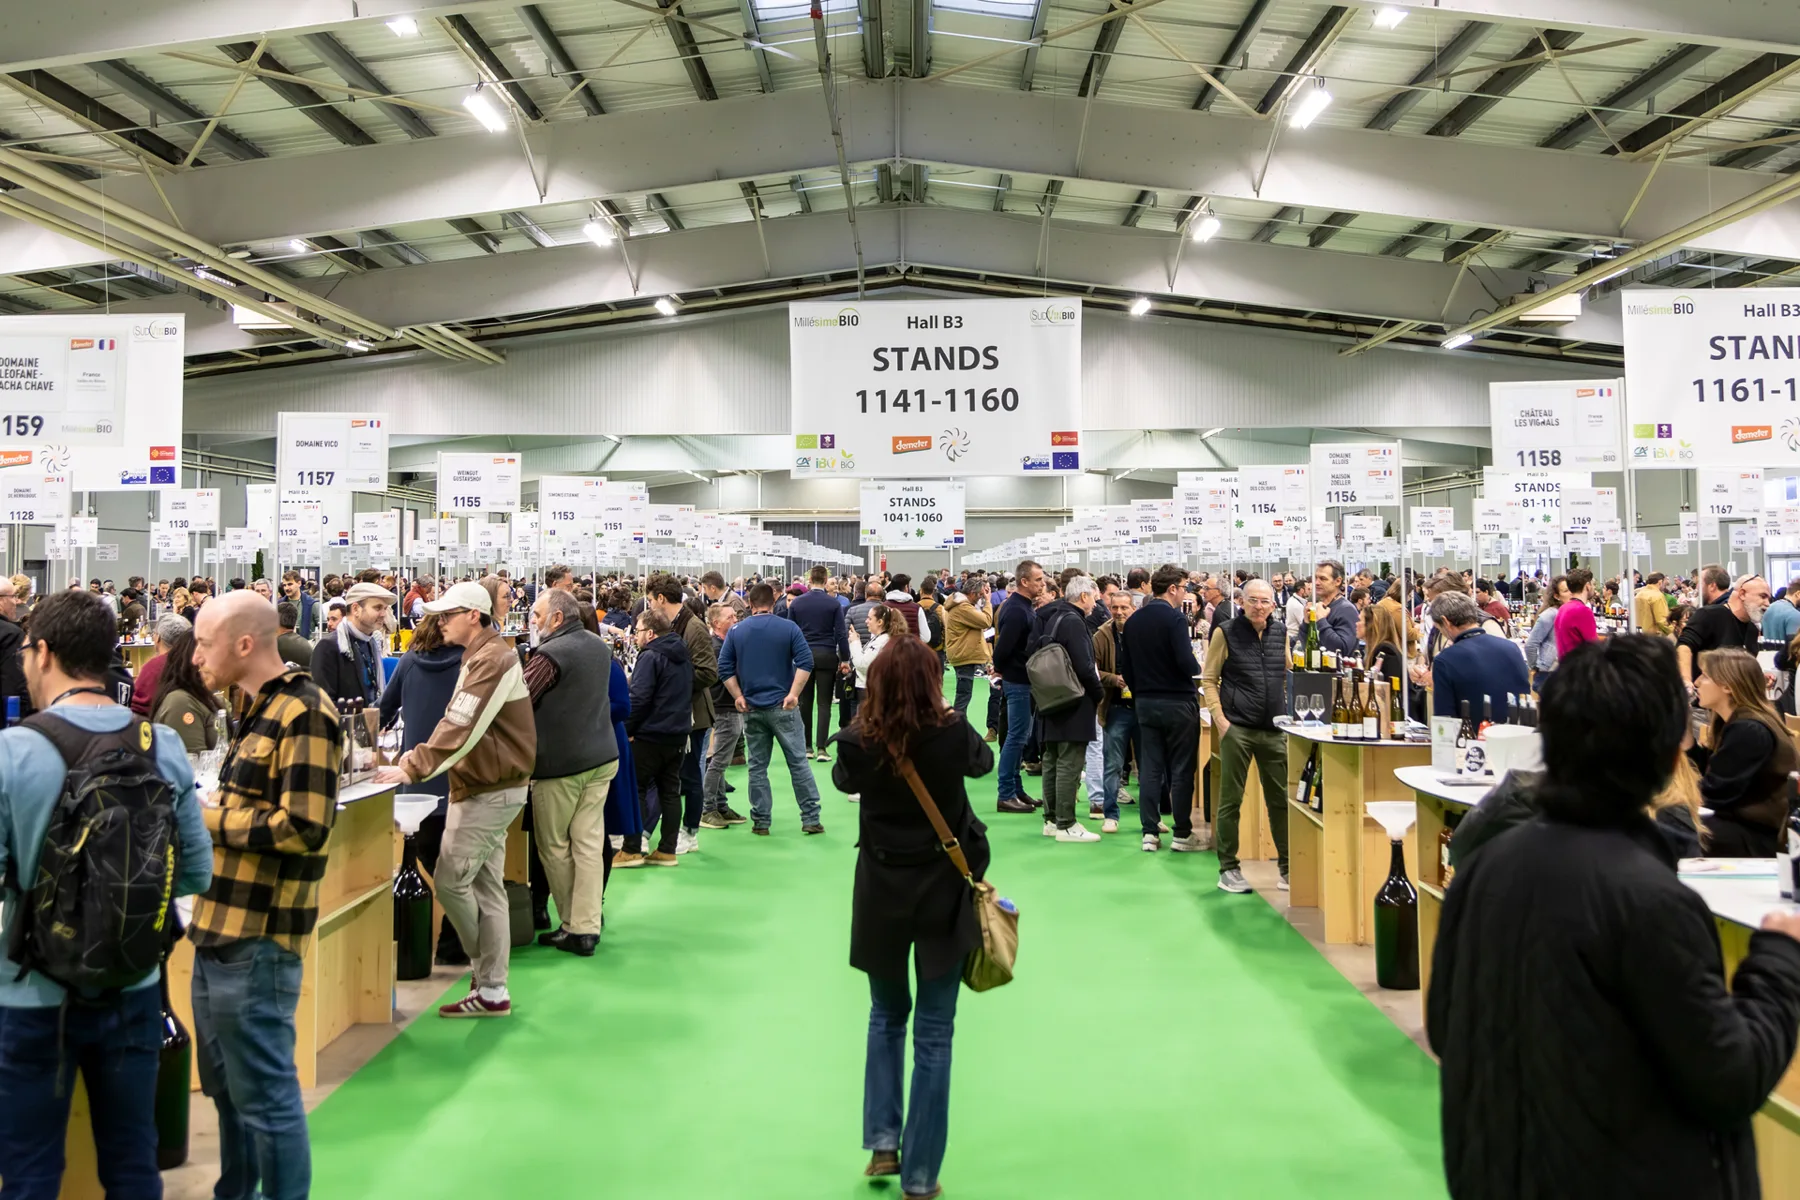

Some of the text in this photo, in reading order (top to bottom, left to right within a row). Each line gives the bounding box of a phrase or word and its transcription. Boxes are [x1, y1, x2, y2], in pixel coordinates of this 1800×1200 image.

[1744, 304, 1776, 317] Hall
[794, 314, 860, 328] MillésimeBIO
[907, 316, 938, 329] Hall
[943, 316, 964, 328] B3
[1710, 336, 1800, 360] STAN
[0, 357, 39, 368] DOMAINE
[873, 346, 1000, 372] STANDS
[24, 381, 54, 391] CHAVE
[1692, 378, 1796, 402] 1161-1
[856, 388, 1020, 414] 1141-1160
[1520, 408, 1552, 418] CHÂTEAU
[2, 415, 44, 436] 159
[1514, 418, 1560, 428] LES VIGNALS
[1516, 450, 1562, 466] 1158
[298, 471, 335, 486] 1157
[1326, 490, 1357, 502] 1156
[453, 496, 480, 508] 1155
[890, 497, 936, 507] STANDS
[1252, 504, 1276, 514] 1154
[1710, 505, 1732, 514] 1167
[10, 511, 34, 520] 1128
[552, 512, 574, 520] 1153
[883, 513, 943, 522] 1041-1060
[1183, 518, 1203, 526] 1152
